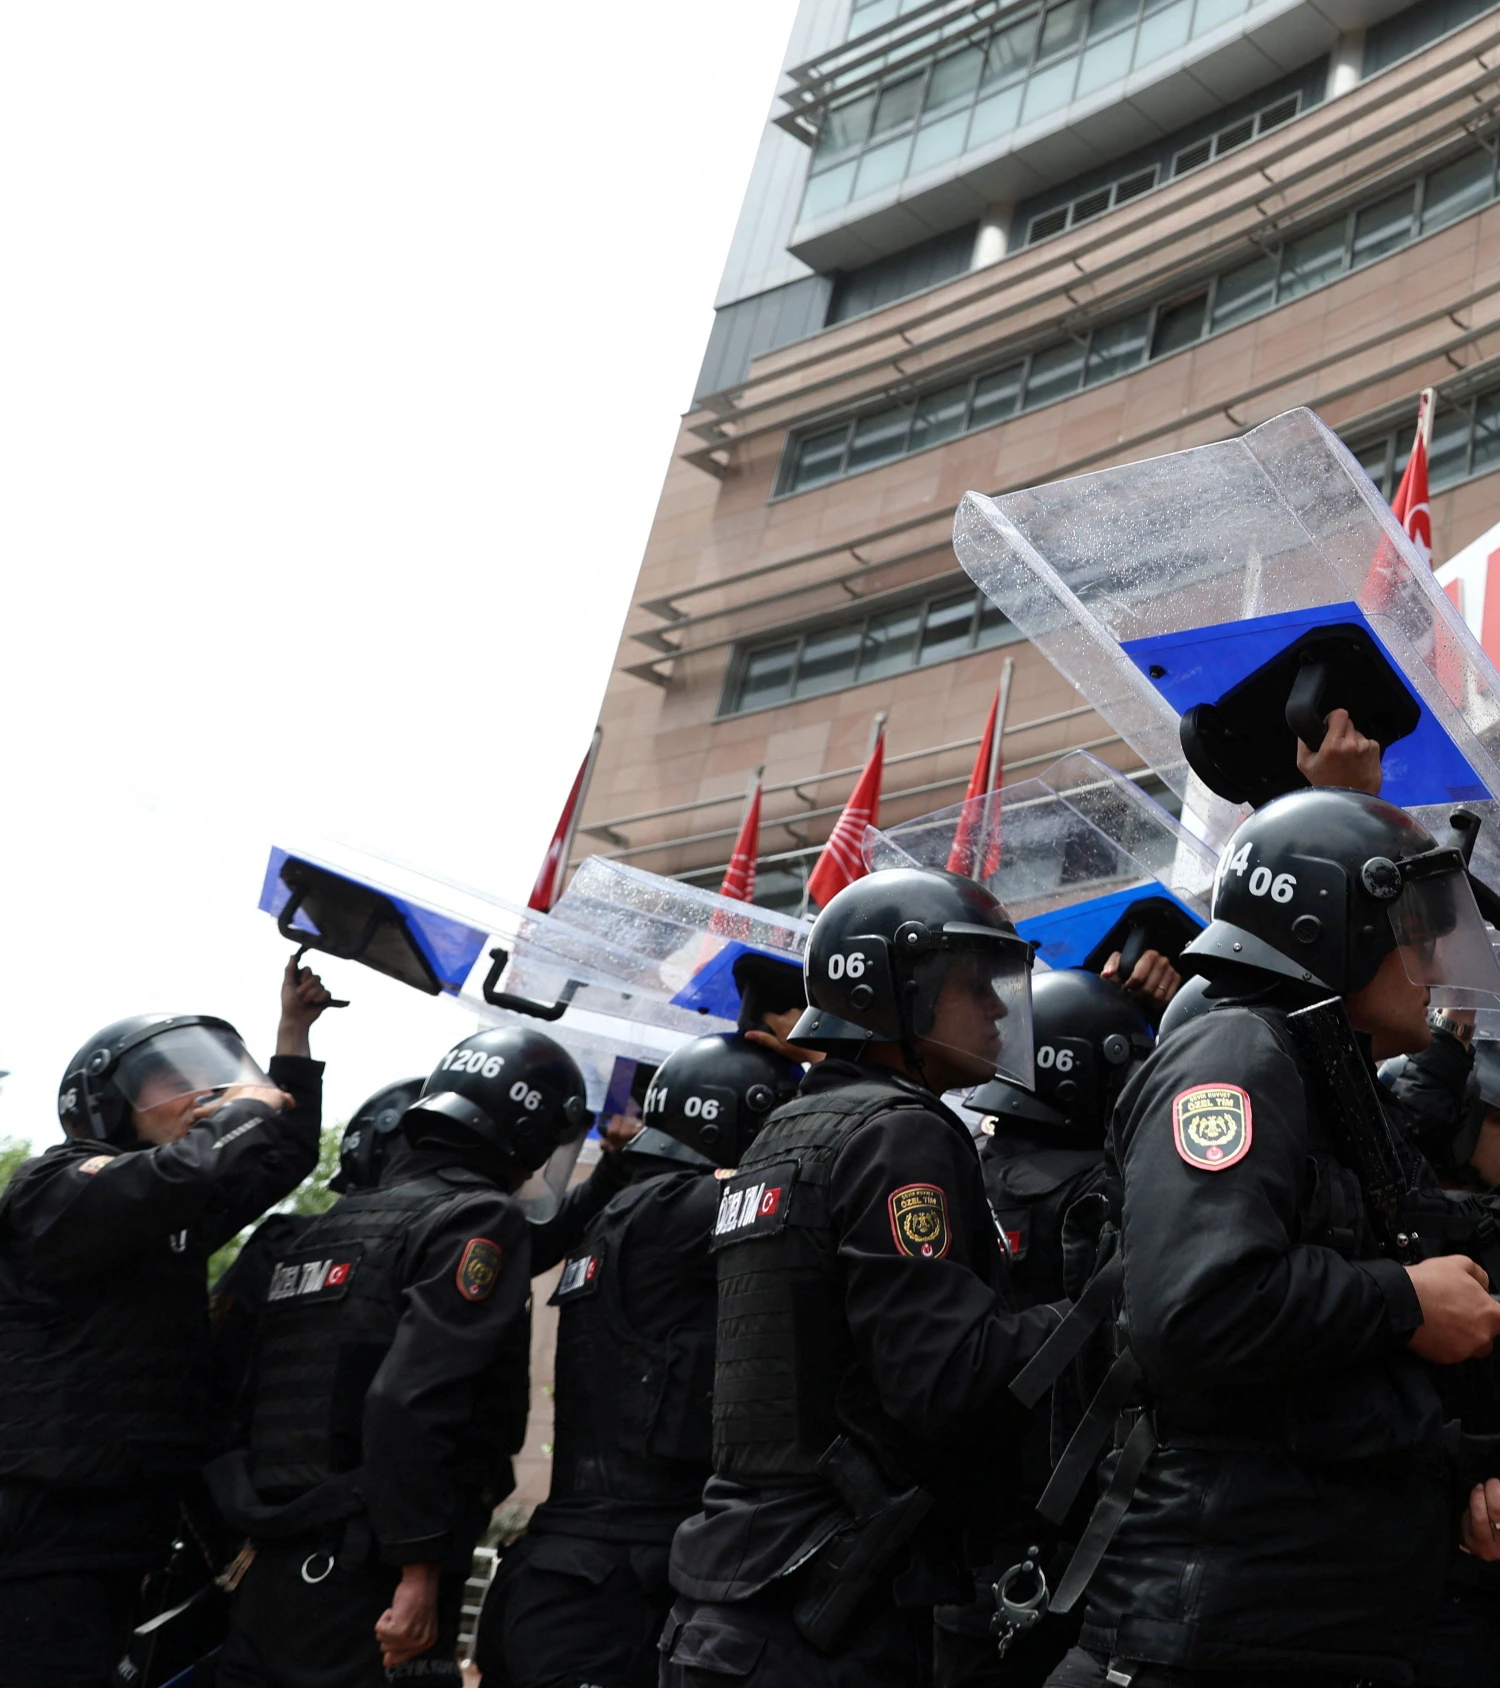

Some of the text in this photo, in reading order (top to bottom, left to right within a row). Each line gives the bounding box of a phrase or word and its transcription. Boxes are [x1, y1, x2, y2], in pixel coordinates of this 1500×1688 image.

[1248, 866, 1297, 903] 06
[828, 951, 865, 980] 06
[441, 1048, 505, 1078] 1206
[1037, 1045, 1074, 1071] 06
[509, 1080, 542, 1110] 06
[683, 1095, 720, 1120] 06
[1187, 1098, 1214, 1111] ÖZEL
